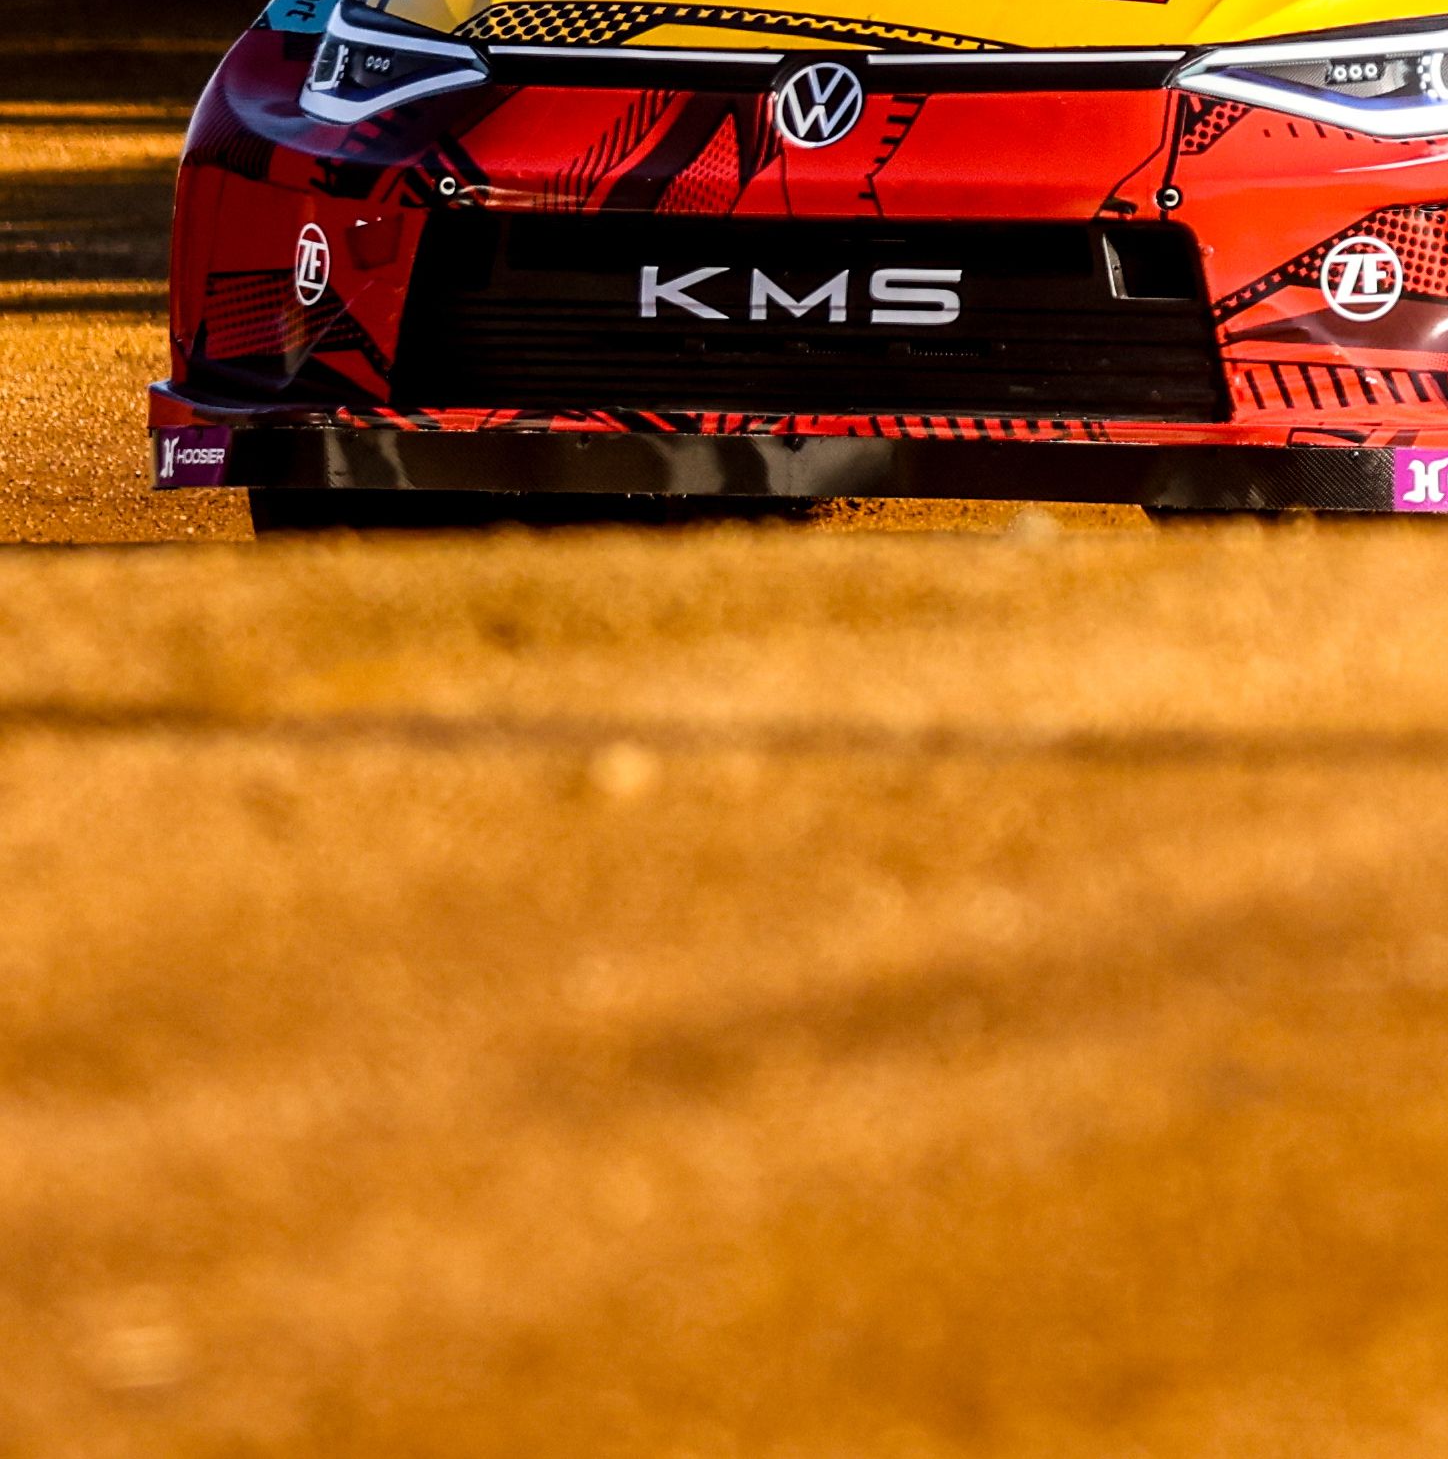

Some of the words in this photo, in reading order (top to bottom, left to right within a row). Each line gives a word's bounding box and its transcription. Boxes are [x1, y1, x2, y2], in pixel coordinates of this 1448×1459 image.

[296, 235, 330, 295] ZF
[1324, 248, 1399, 308] ZF
[640, 266, 963, 325] KMS
